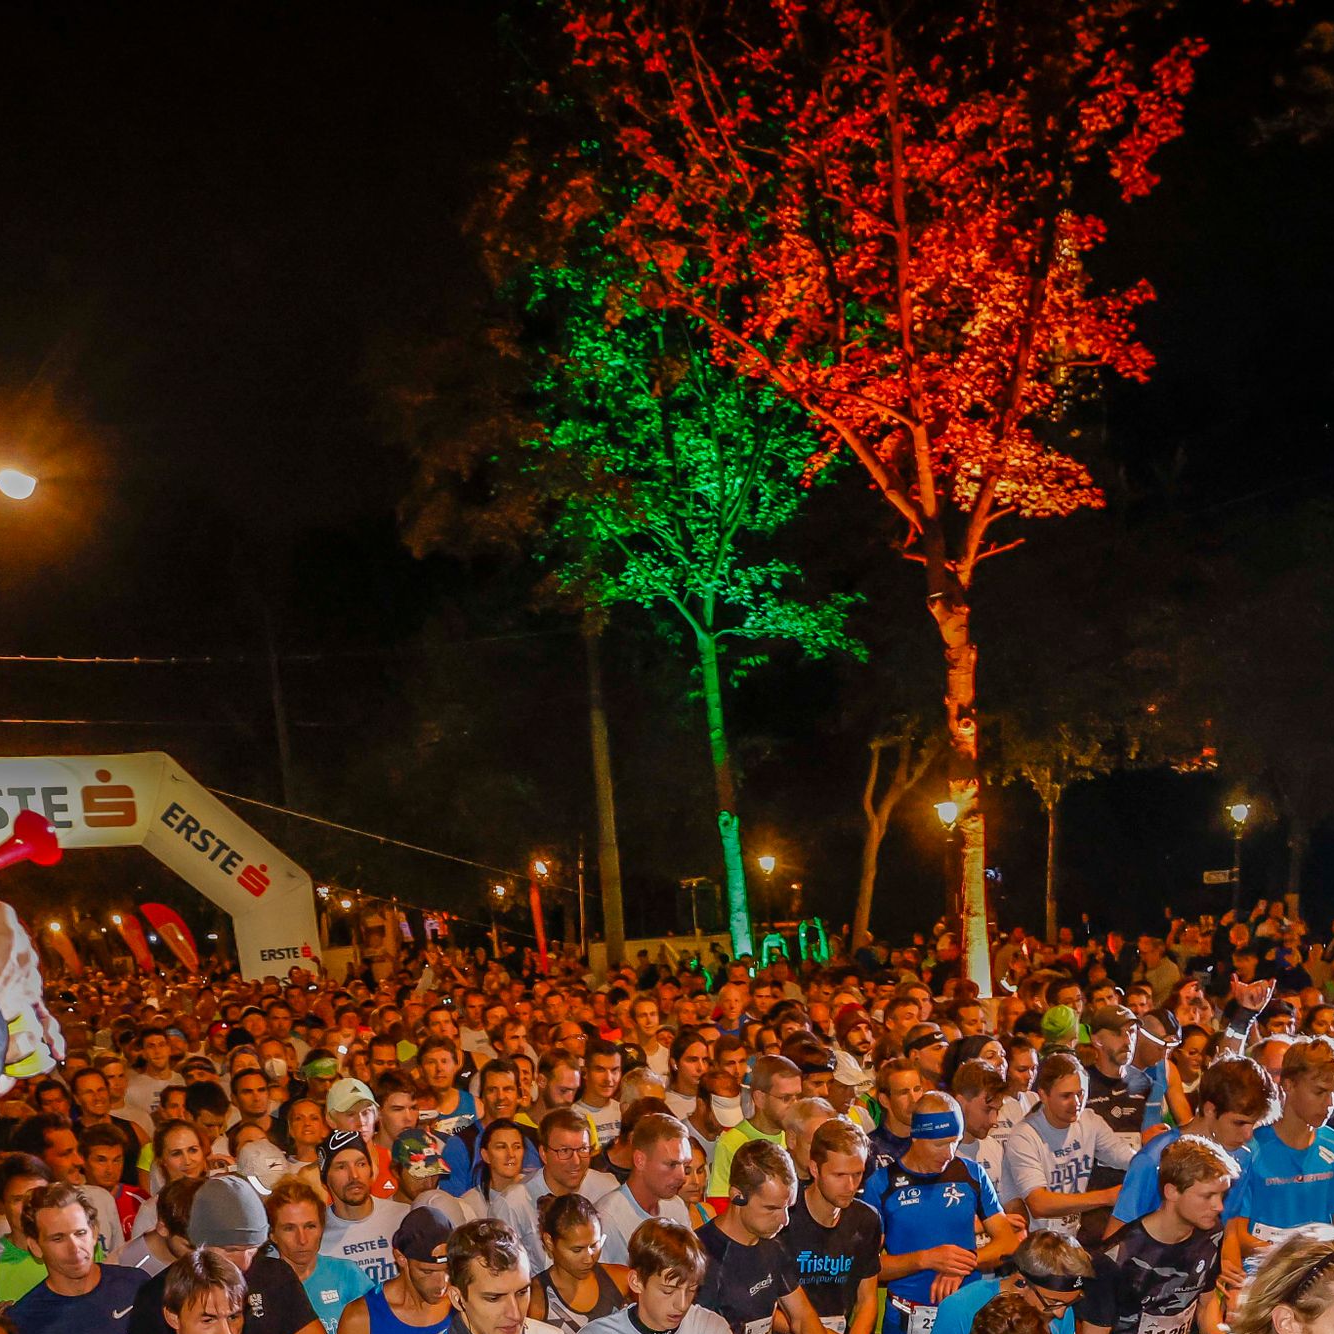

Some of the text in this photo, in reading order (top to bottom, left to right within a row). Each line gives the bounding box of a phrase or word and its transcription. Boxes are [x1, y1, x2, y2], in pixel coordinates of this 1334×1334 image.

[161, 802, 243, 876] ERSTE
[260, 946, 300, 961] ERSTE
[343, 1240, 378, 1255] ERSTE
[796, 1250, 853, 1276] Tristyle
